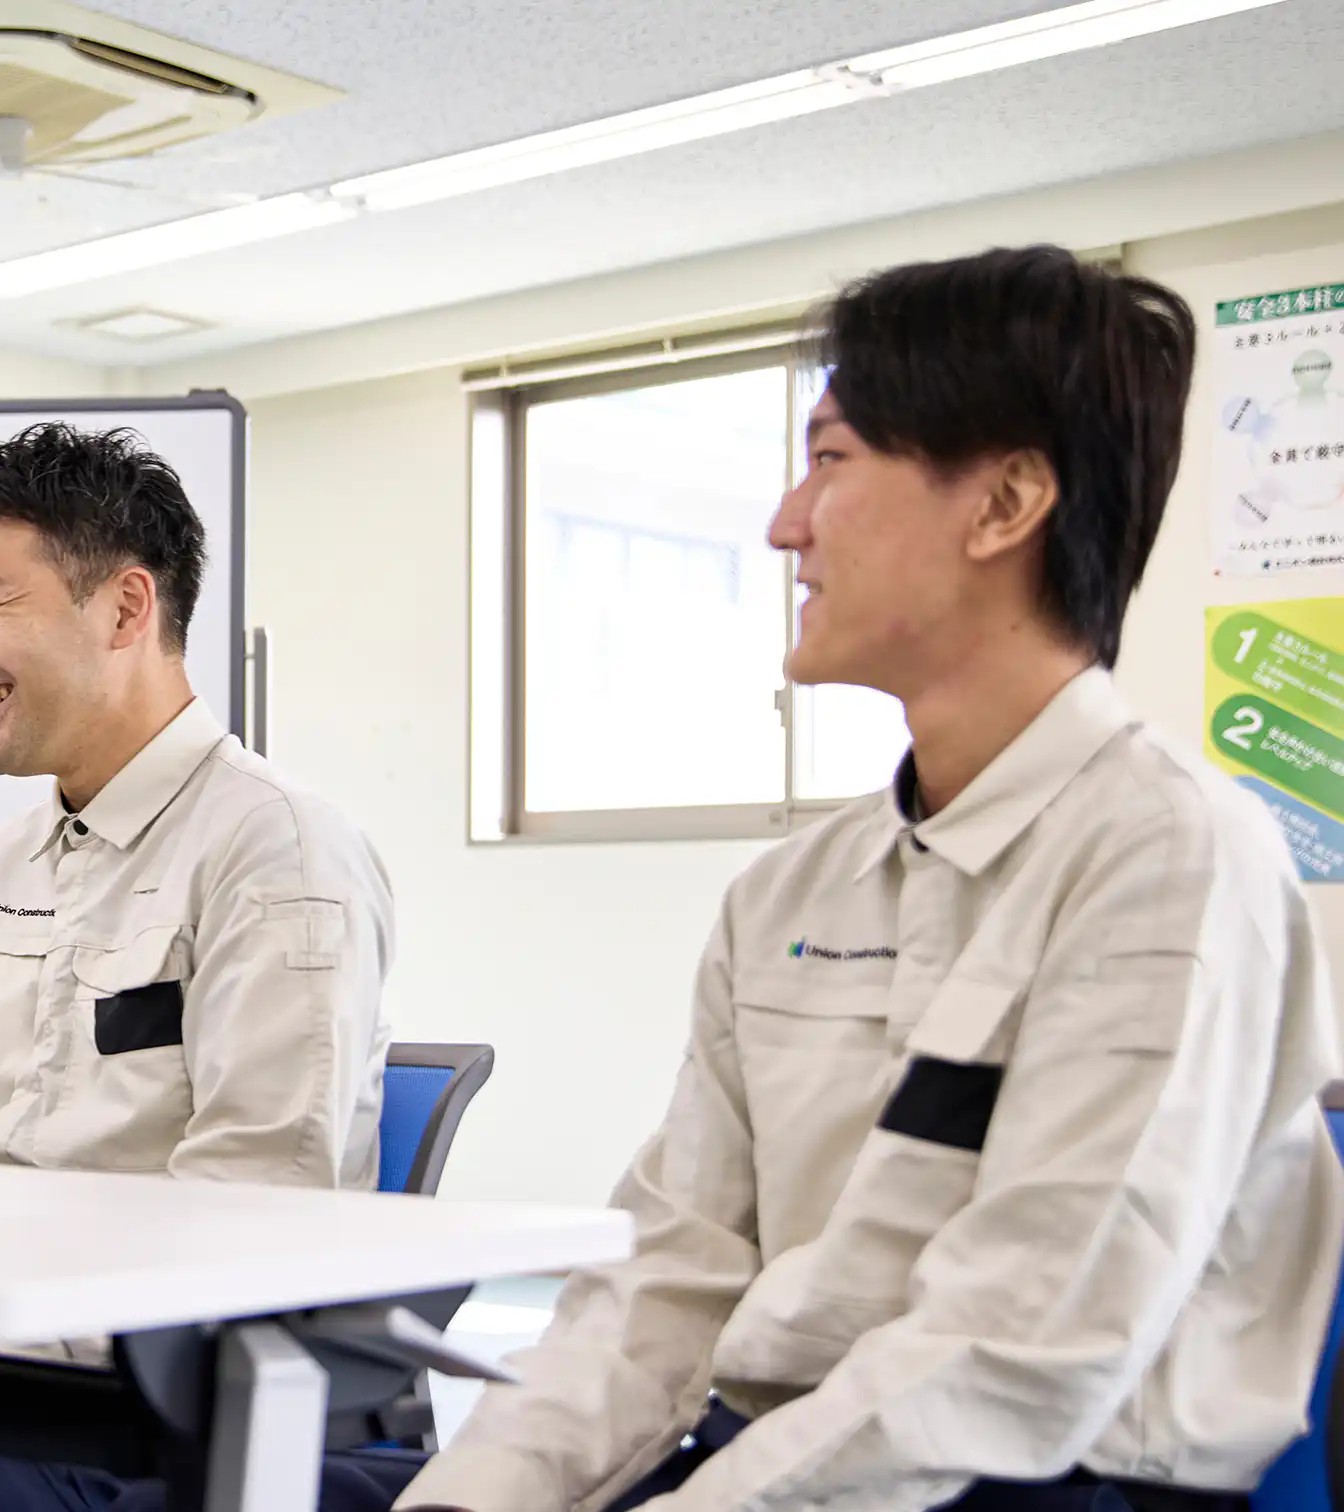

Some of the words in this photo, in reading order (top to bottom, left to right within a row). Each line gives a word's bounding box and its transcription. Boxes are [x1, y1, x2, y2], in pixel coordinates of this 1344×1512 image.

[1233, 627, 1258, 664] 1
[1221, 705, 1264, 750] 2
[805, 944, 842, 960] Union
